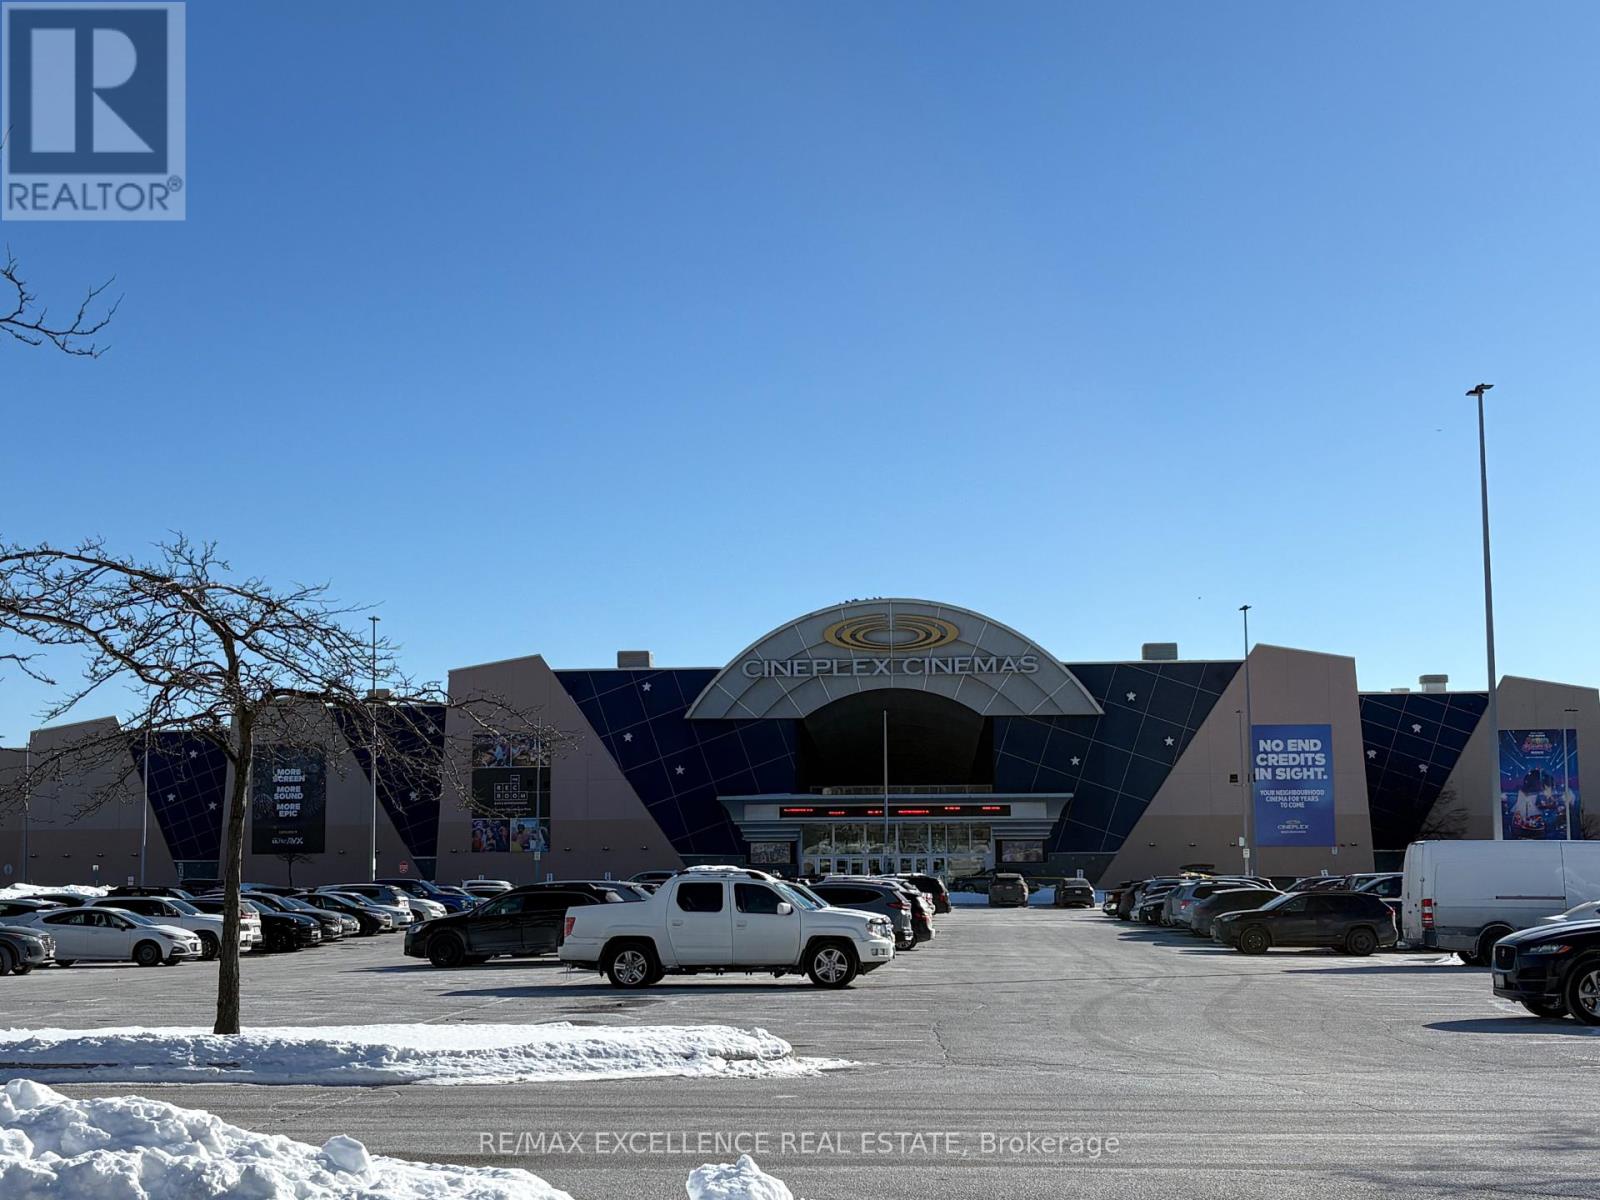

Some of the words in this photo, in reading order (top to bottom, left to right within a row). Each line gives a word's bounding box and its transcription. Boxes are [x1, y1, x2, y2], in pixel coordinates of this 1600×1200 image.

[741, 658, 891, 679] CINEPLEX
[902, 655, 1040, 677] CINEMAS
[1259, 739, 1284, 752] NO
[1287, 739, 1322, 752] END
[1256, 753, 1326, 766] CREDITS
[276, 768, 301, 776] MORE
[1255, 767, 1272, 780] IN
[1275, 767, 1328, 780] SIGHT.
[276, 785, 301, 793] MORE
[273, 792, 304, 800] SOUND
[276, 802, 301, 810] MORE
[278, 810, 299, 818] EPIC
